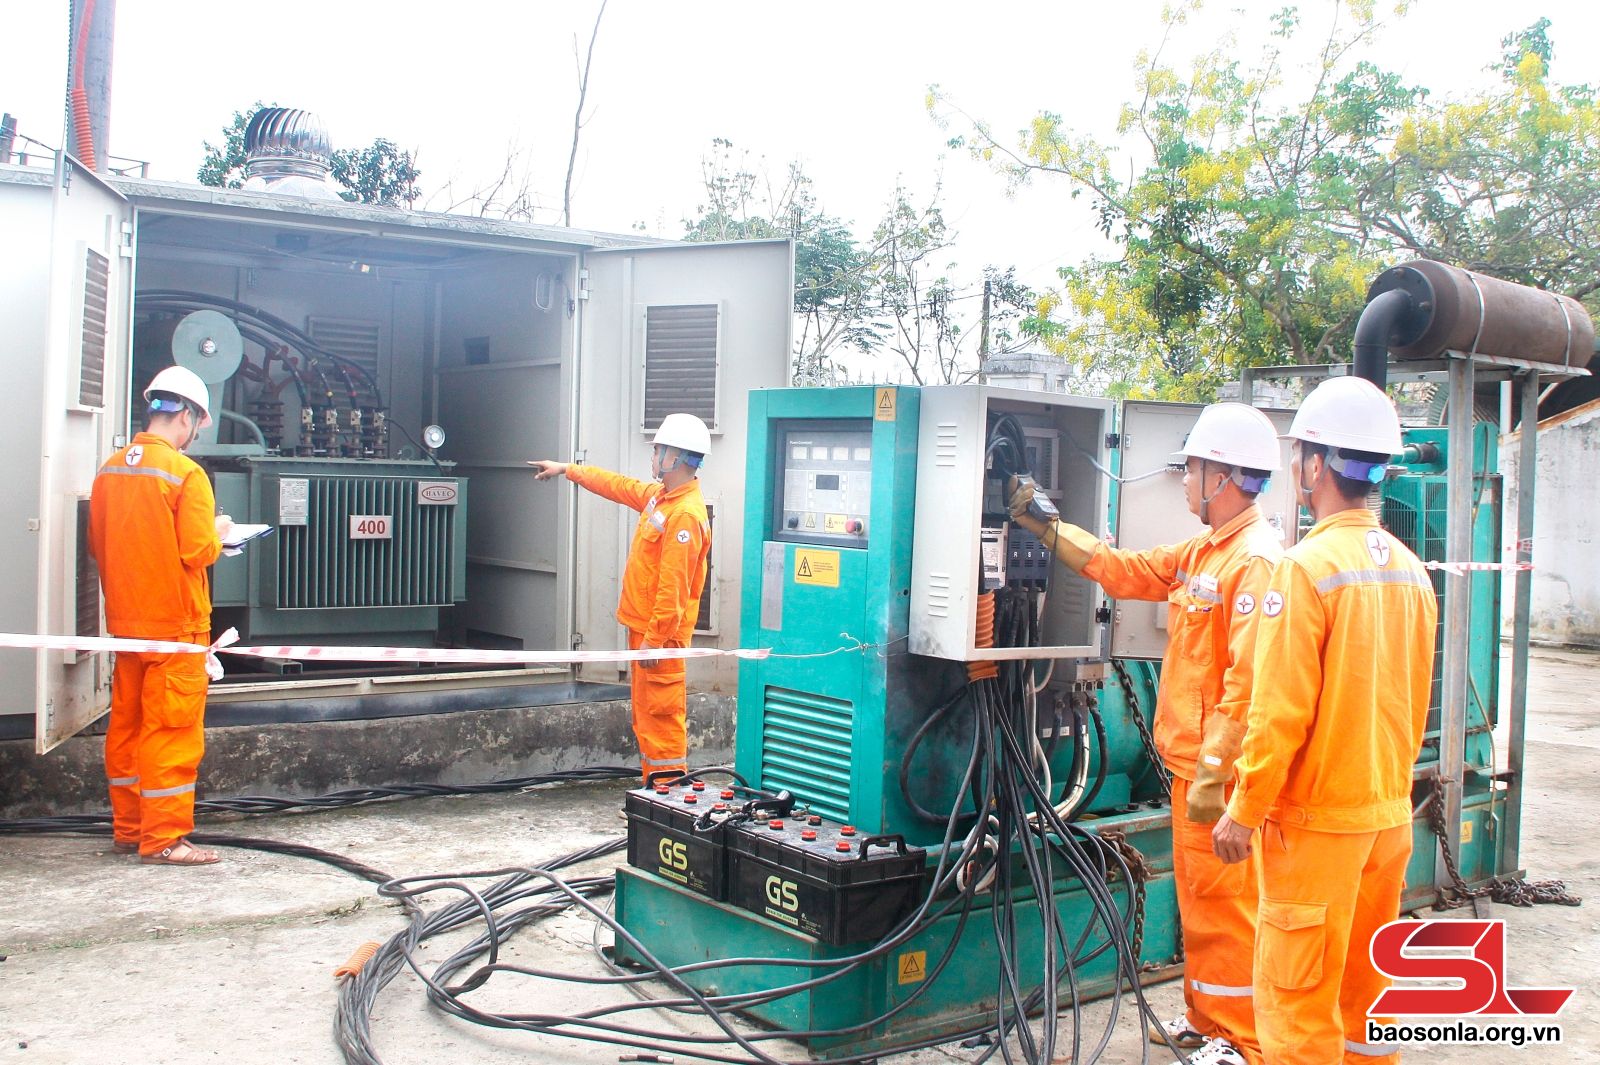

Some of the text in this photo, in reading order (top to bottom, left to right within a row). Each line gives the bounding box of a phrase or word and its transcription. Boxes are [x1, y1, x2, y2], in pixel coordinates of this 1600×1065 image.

[425, 490, 452, 498] HAVEC
[357, 520, 386, 534] 400
[658, 837, 688, 871] GS
[765, 875, 799, 912] GS
